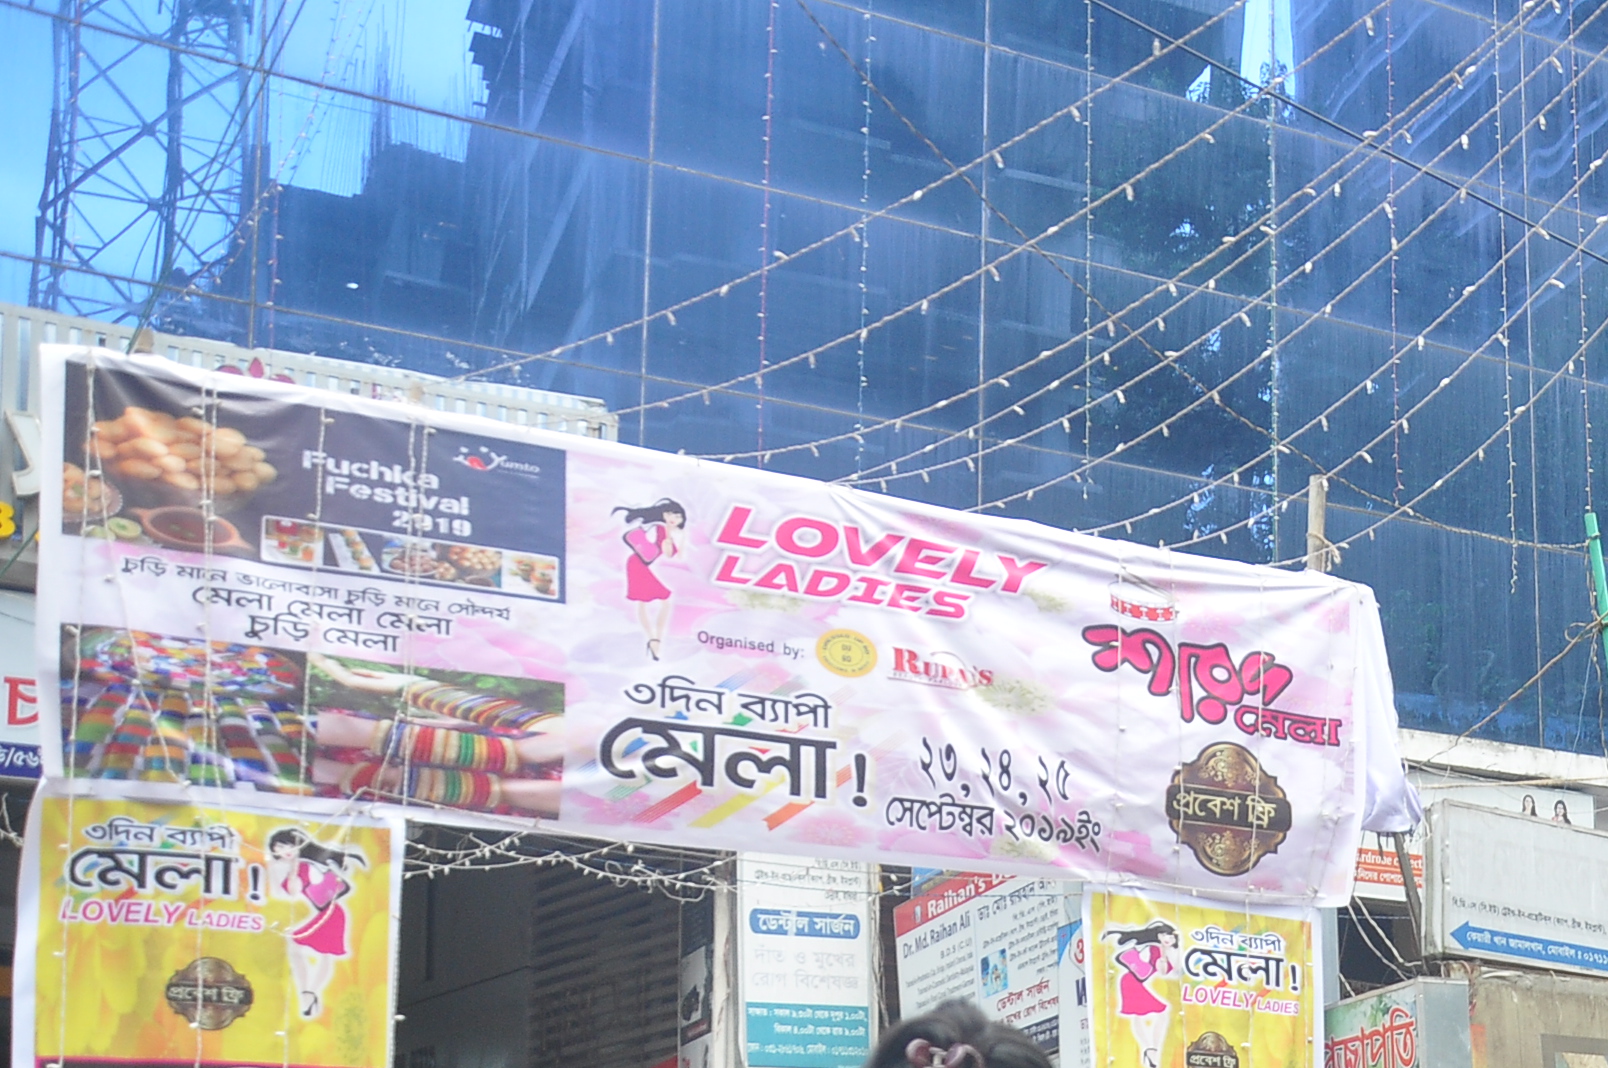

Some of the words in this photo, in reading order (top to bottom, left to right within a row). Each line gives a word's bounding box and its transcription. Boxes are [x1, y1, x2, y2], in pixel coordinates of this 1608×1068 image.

[302, 449, 440, 489] Fuchka
[325, 475, 470, 516] Festival
[392, 510, 473, 538] 2019
[716, 505, 1048, 594] LOVELY
[121, 555, 168, 577] চুড়ি
[175, 565, 227, 583] মানে
[236, 572, 339, 601] ভালোবাসা
[715, 555, 972, 619] LADIES
[192, 586, 274, 612] মেলা
[287, 599, 366, 627] মেলা
[376, 611, 453, 637] মেলা
[244, 612, 310, 642] চুড়ি
[323, 630, 403, 653] মেলা
[697, 631, 775, 653] Organised
[740, 692, 832, 730] ব্যাপী
[1233, 704, 1343, 746] মেলা
[1037, 754, 1070, 801] ২৫
[885, 793, 994, 837] সেপ্টেম্বর
[1004, 810, 1102, 853] ২০১৯ইং
[1172, 791, 1241, 821] প্রবেশ
[1246, 797, 1277, 829] ফ্রি
[60, 898, 183, 925] LOVELY
[187, 909, 264, 931] LADIES
[925, 876, 986, 919] Raihan's
[814, 912, 856, 936] সার্জন
[1239, 932, 1281, 952] ব্যাপী
[1182, 985, 1256, 1008] LOVELY
[1257, 1000, 1299, 1014] LADIES
